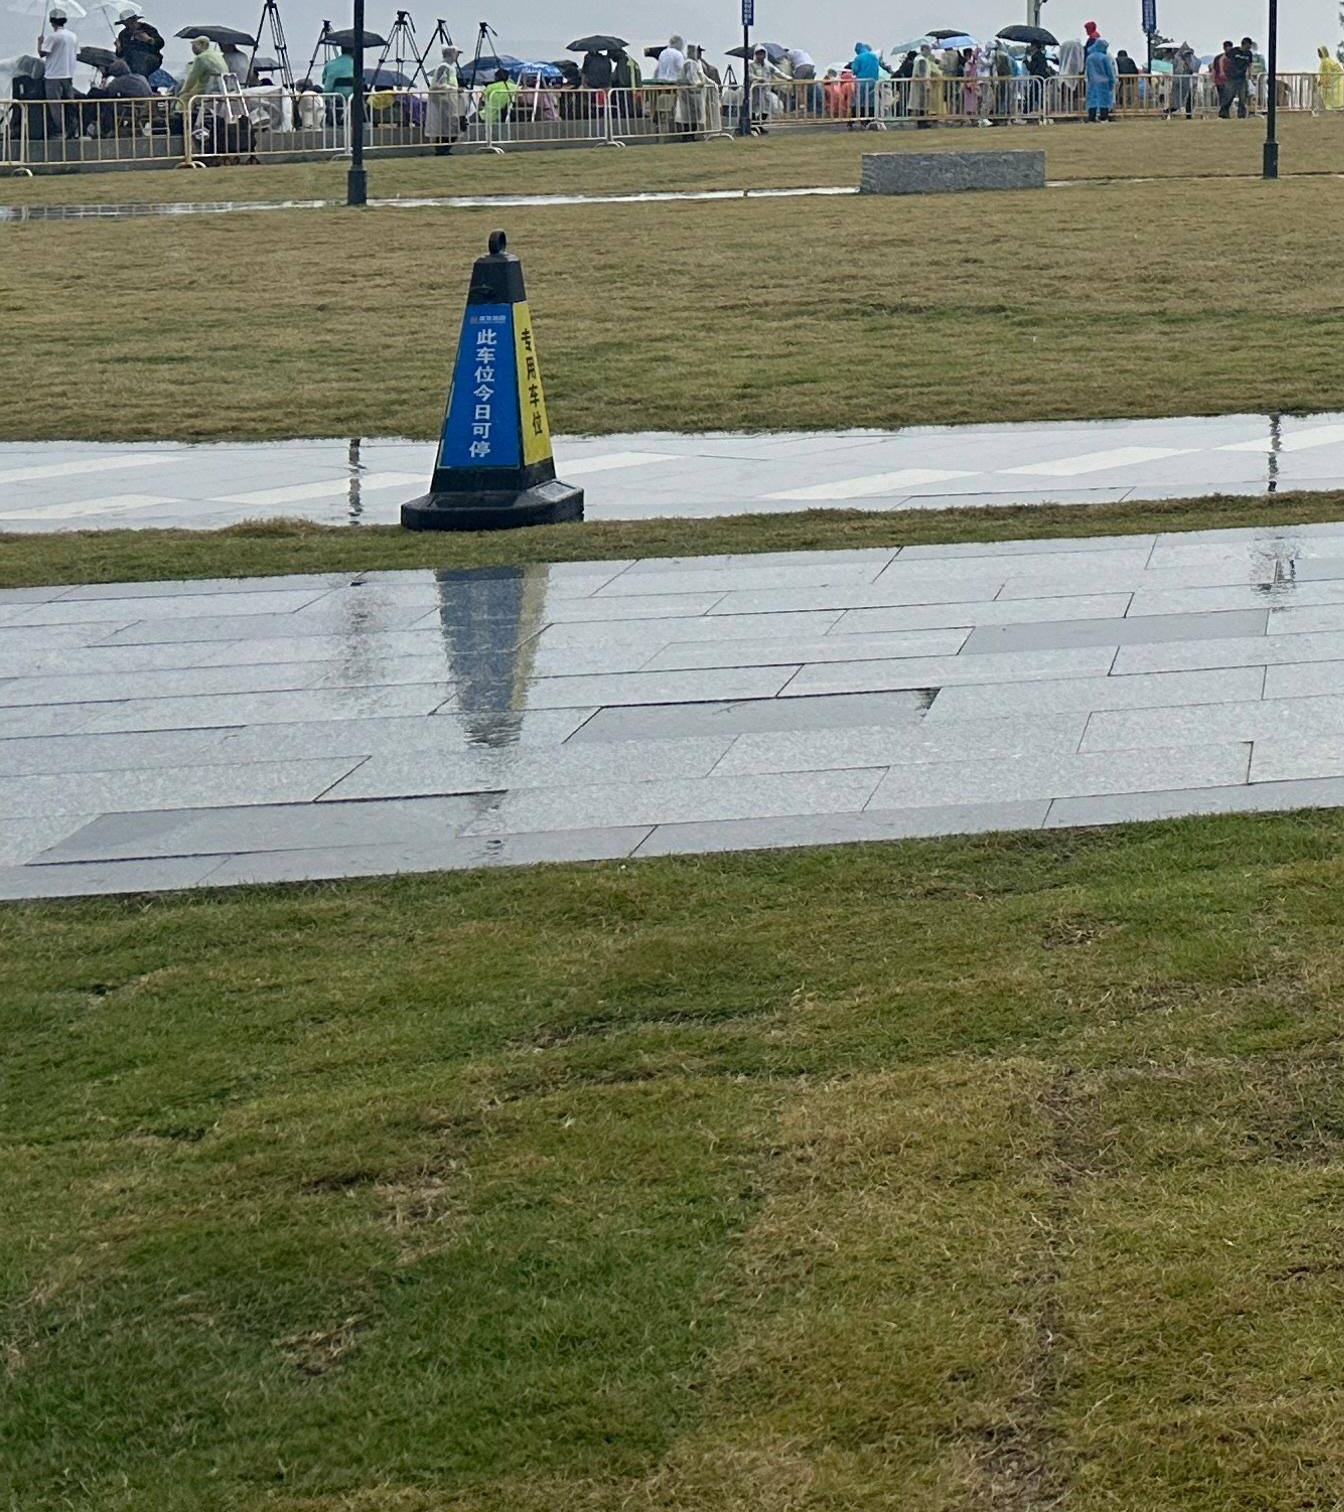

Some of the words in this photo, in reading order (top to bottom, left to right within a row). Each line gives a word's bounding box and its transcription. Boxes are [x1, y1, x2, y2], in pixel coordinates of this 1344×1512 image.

[469, 328, 498, 459] 此车位今日可停
[520, 328, 544, 436] 专用车位
